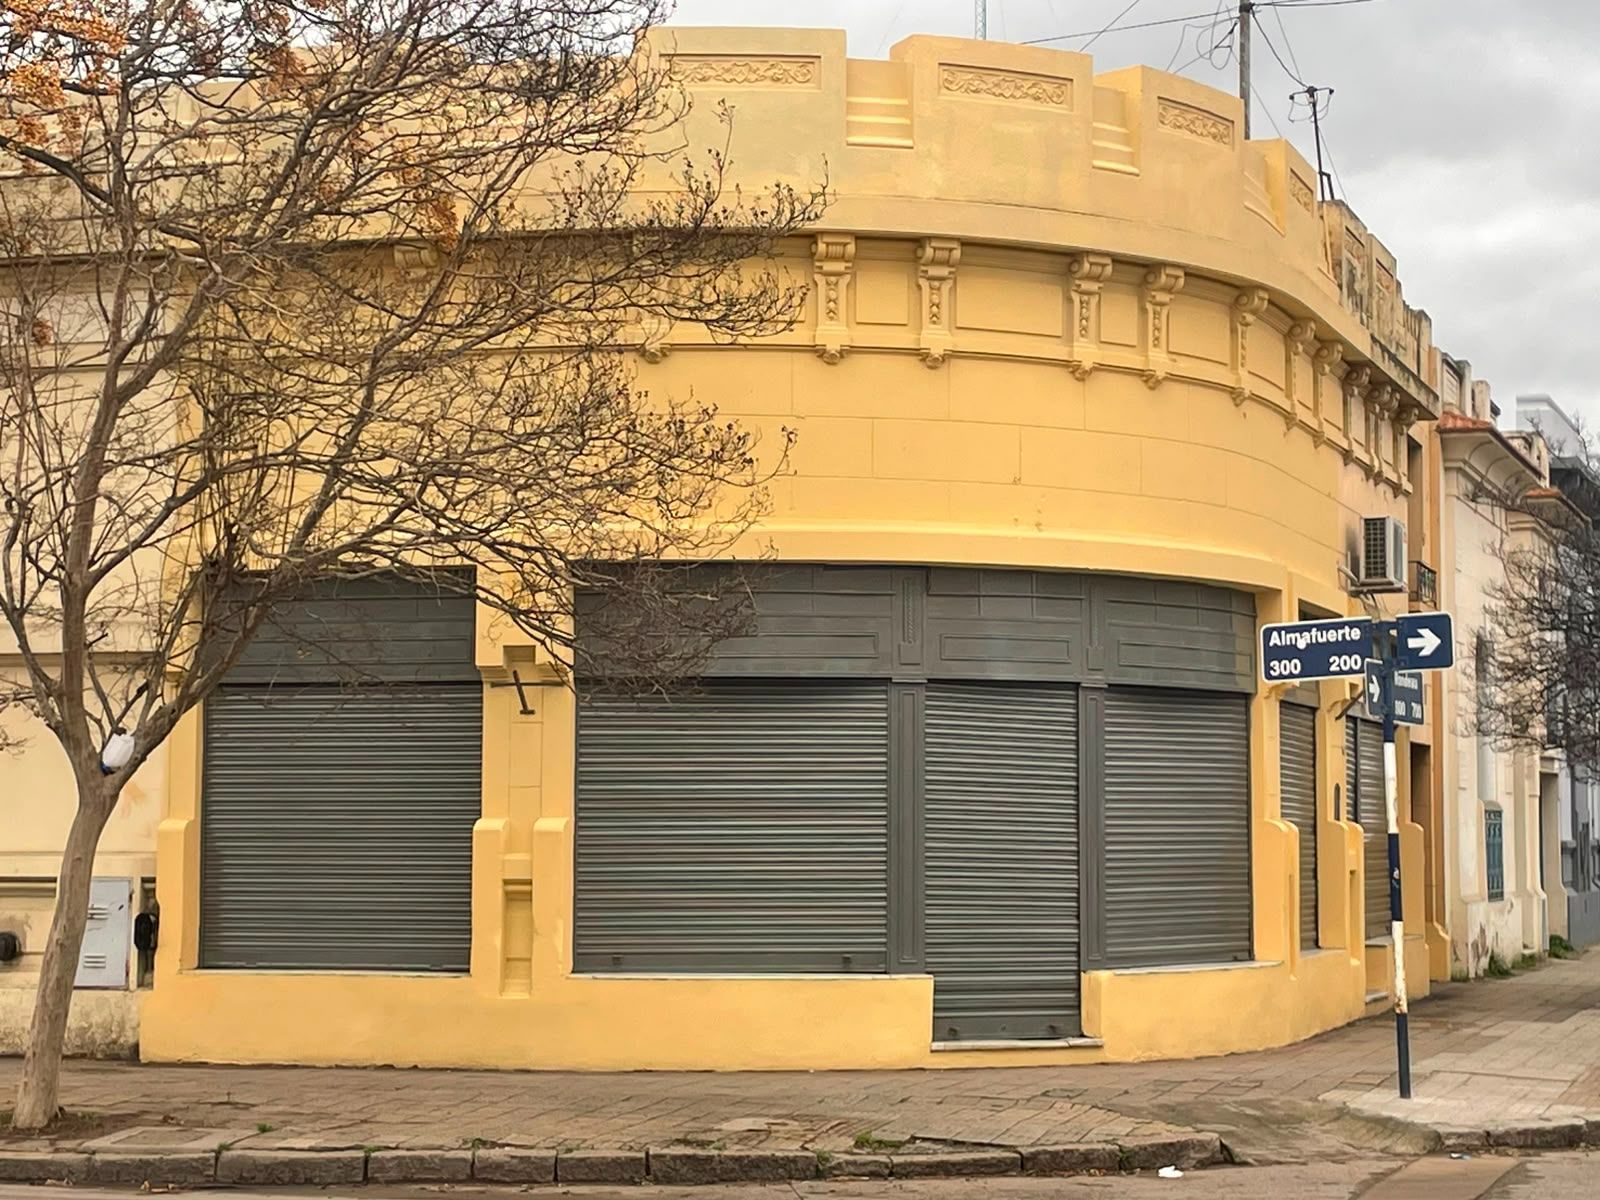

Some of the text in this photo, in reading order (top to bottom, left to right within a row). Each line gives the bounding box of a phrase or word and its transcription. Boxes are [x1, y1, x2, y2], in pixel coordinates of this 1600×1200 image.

[1269, 625, 1361, 647] Almafuerte
[1269, 654, 1361, 676] 300 200
